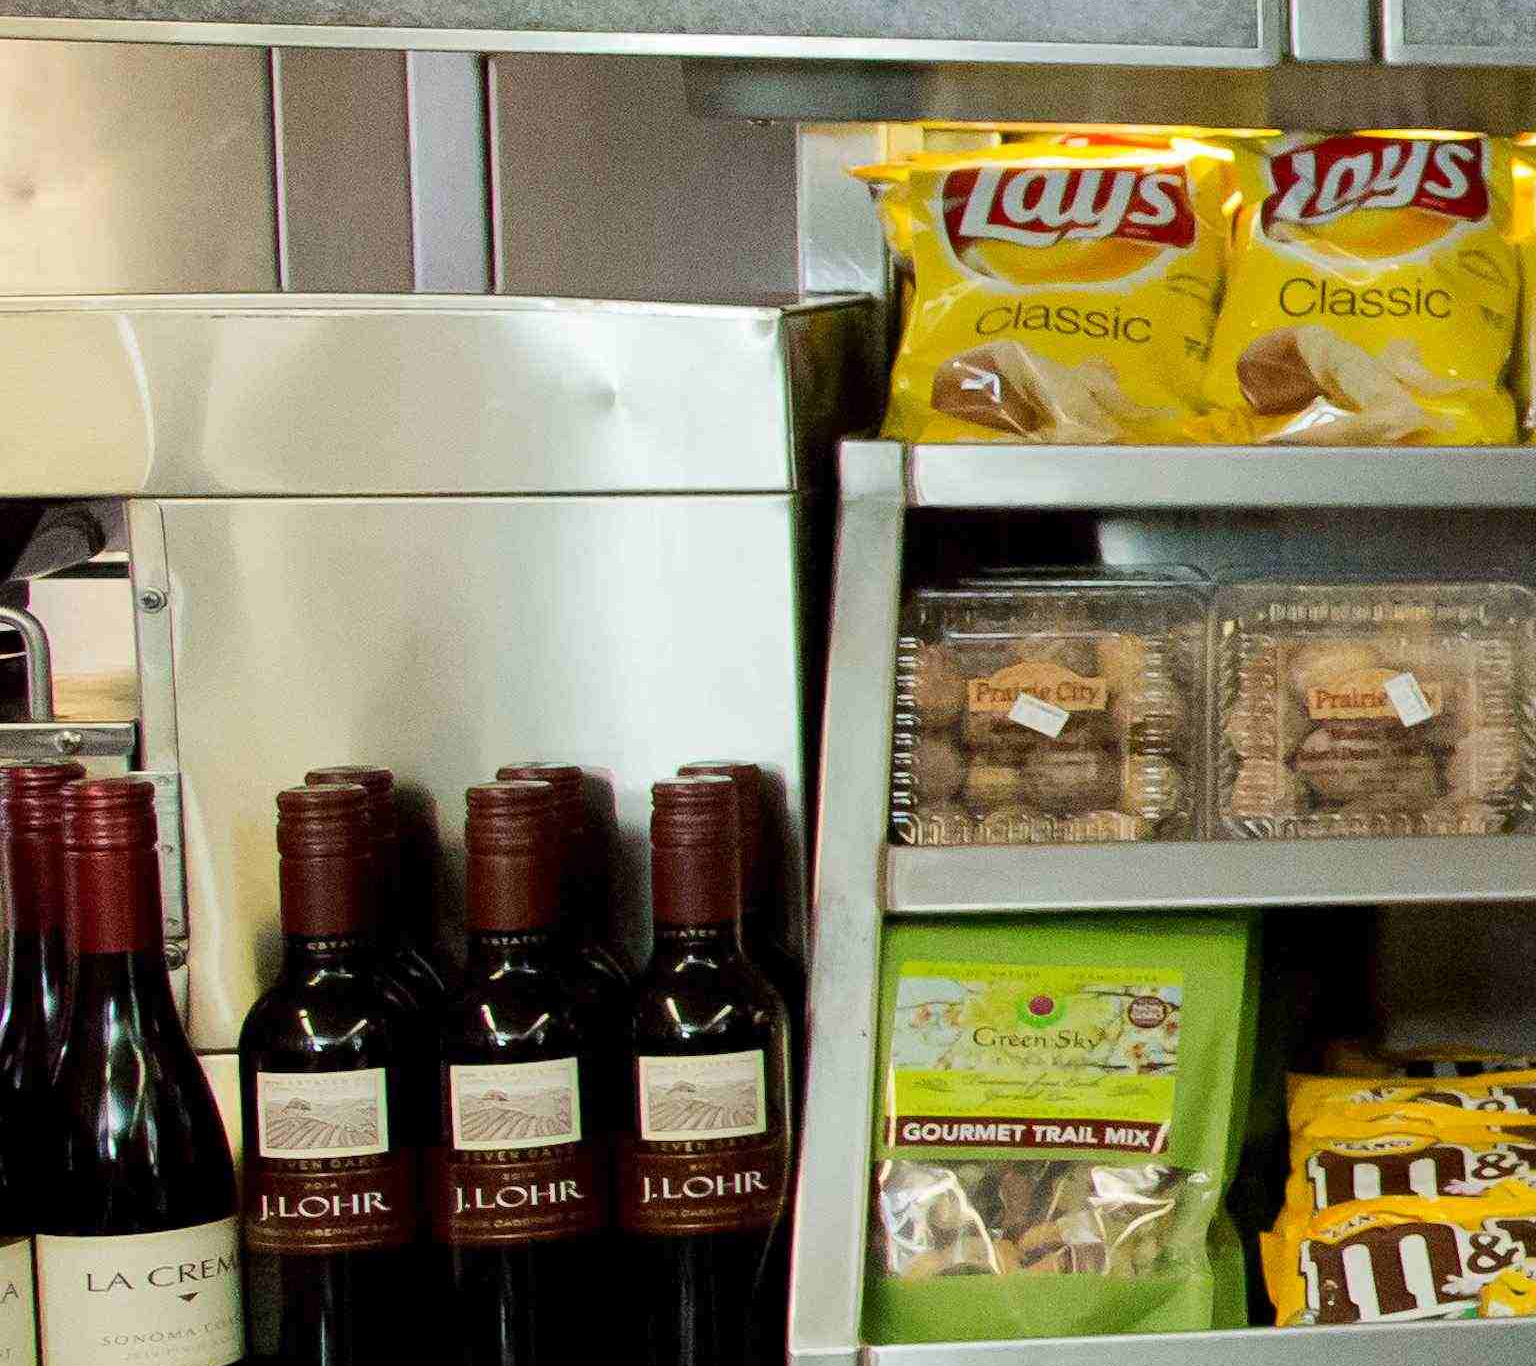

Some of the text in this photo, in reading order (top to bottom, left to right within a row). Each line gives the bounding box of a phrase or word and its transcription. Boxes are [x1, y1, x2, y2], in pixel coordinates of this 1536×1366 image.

[1277, 276, 1452, 320] Classic
[974, 301, 1152, 345] Classic
[972, 1025, 1047, 1050] Green
[902, 1122, 1152, 1148] GOURMET TRAIL MIX
[454, 1178, 586, 1213] J.LOHR
[642, 1169, 769, 1204] J.LOHR
[259, 1191, 392, 1221] J.LOHR
[86, 1255, 242, 1293] LA CREM
[100, 1328, 194, 1348] SONOMA
